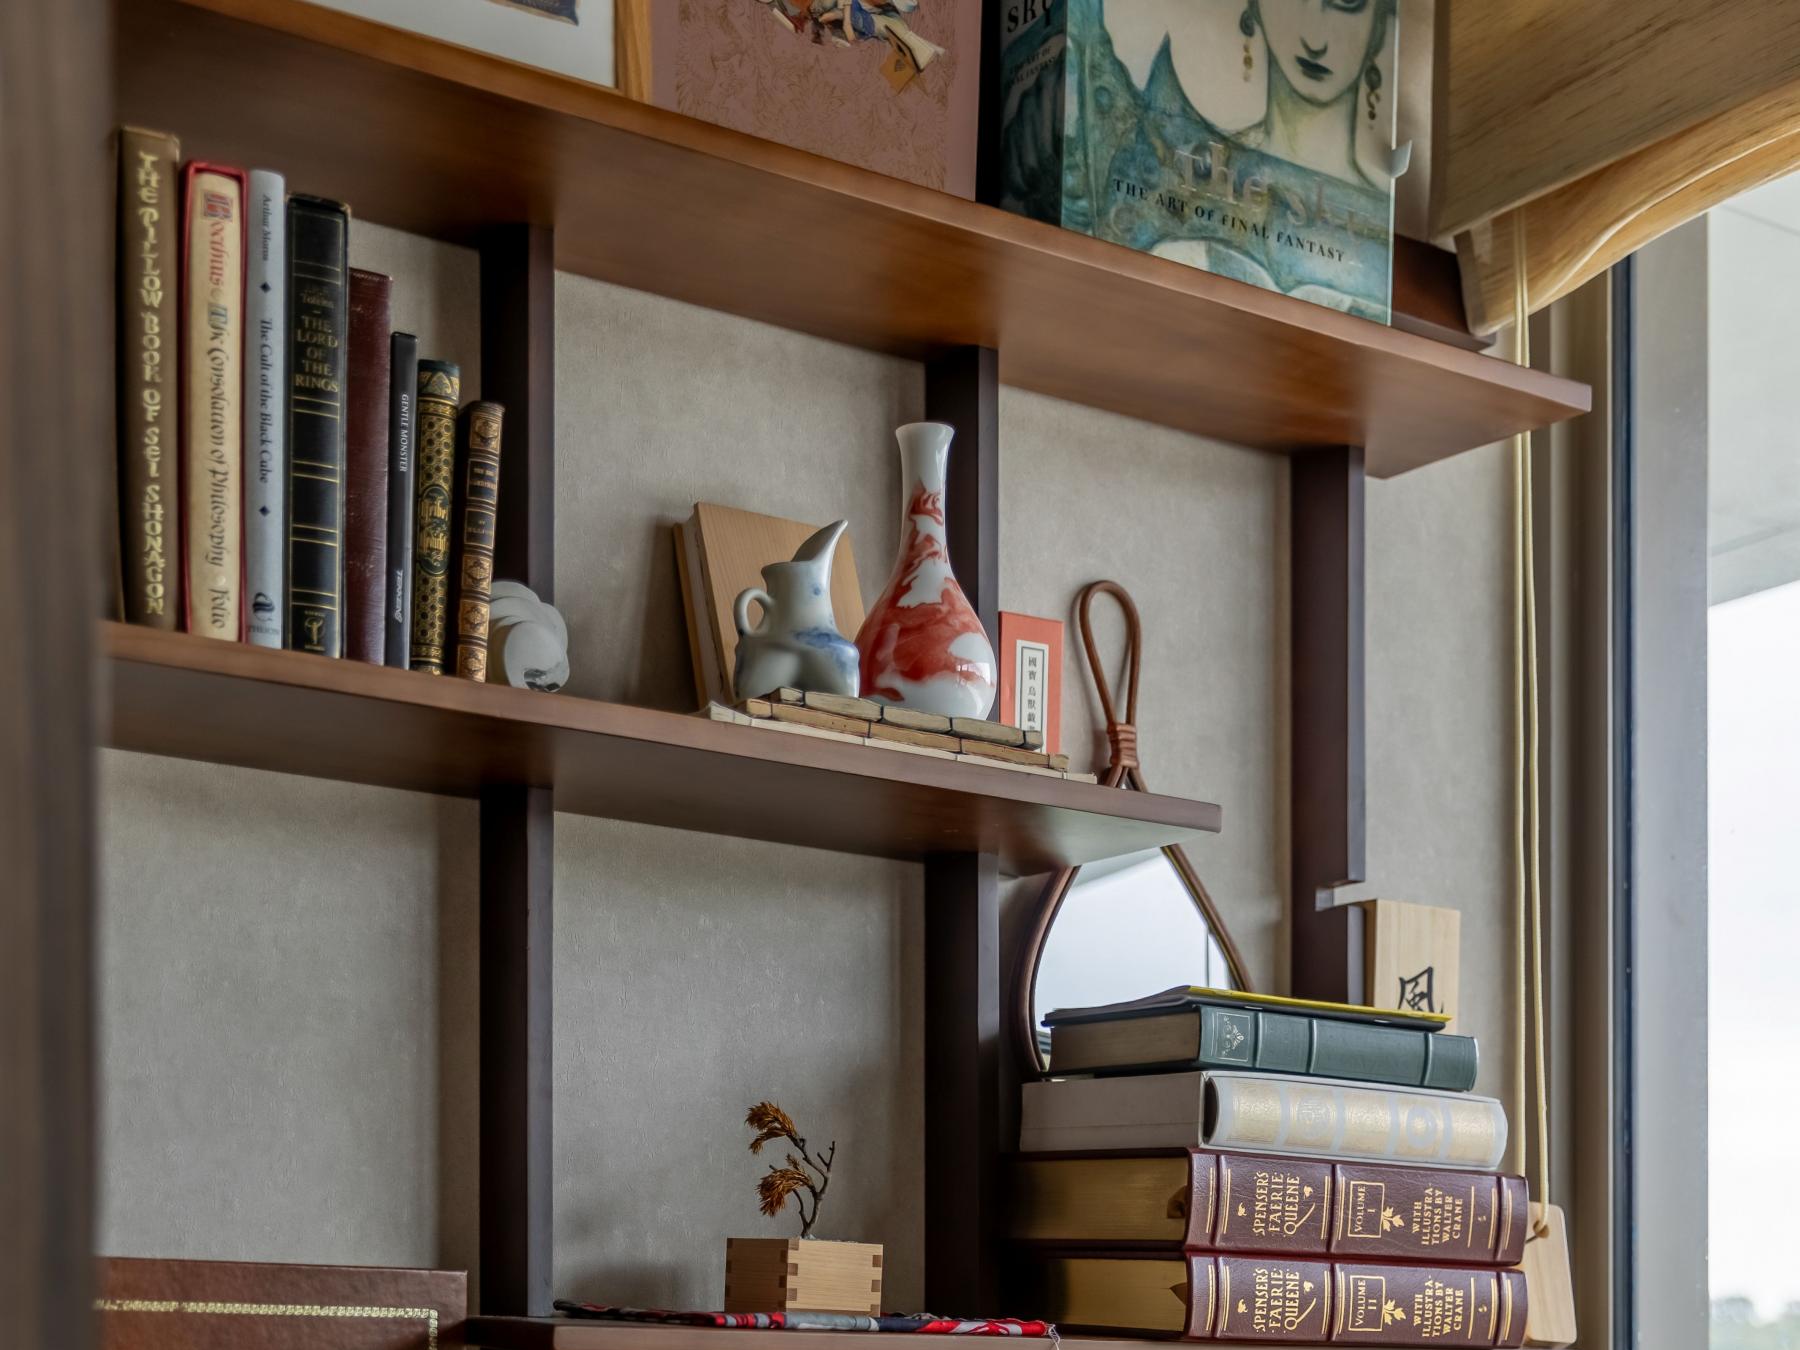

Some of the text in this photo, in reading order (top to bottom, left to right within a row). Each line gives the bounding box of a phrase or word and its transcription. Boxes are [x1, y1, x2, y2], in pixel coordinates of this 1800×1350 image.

[262, 193, 273, 230] Arthur
[1113, 178, 1346, 262] THE ART OF FINAL FANTASY
[297, 329, 339, 348] LORD
[302, 315, 333, 333] THE
[138, 150, 165, 615] THE PILLOW BOOK OF SEI SHONAGON
[295, 374, 339, 393] RINGS
[302, 360, 333, 377] THE
[258, 318, 274, 484] The Cult of the Black Cube
[399, 393, 409, 472] GENTLE MONSTER
[204, 468, 230, 567] Philosophy
[1252, 1170, 1269, 1236] SPENSER'S
[1268, 1172, 1284, 1232] FAERIE
[1284, 1176, 1311, 1235] QUEENE
[1354, 1185, 1366, 1232] VOLUME
[1412, 1201, 1423, 1233] WITH
[1421, 1183, 1434, 1245] ILLUSTRA-
[1431, 1189, 1443, 1245] TIONS BY
[1442, 1195, 1454, 1243] WALTER
[1452, 1198, 1463, 1239] CRANE
[1252, 1267, 1269, 1332] SPENSER'S
[1268, 1269, 1283, 1328] FAERIE
[1284, 1271, 1311, 1331] QUEENE
[1355, 1279, 1366, 1326] VOLUME
[1367, 1299, 1377, 1310] II
[1413, 1294, 1423, 1326] WITH
[1422, 1275, 1434, 1337] ILLUSTRA-
[1432, 1281, 1443, 1337] TIONS BY
[1442, 1287, 1454, 1335] WALTER
[1453, 1289, 1464, 1330] CRANE
